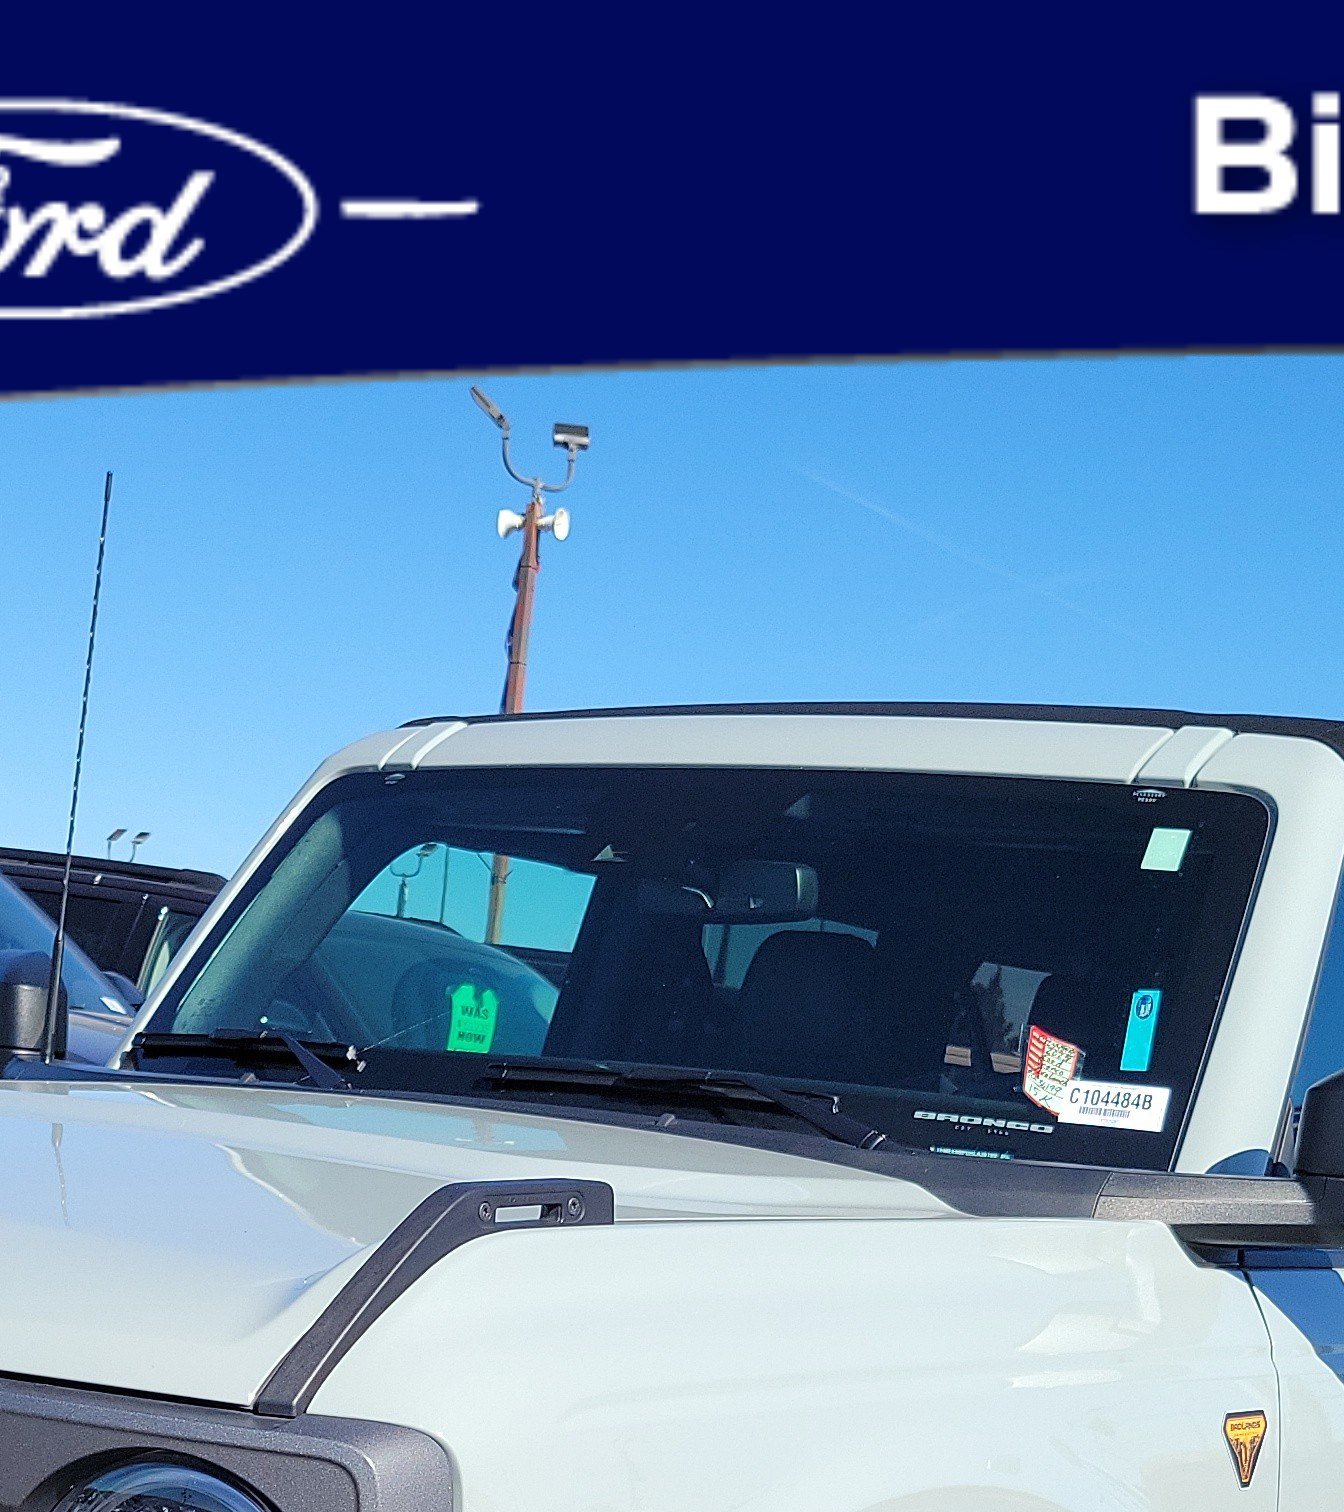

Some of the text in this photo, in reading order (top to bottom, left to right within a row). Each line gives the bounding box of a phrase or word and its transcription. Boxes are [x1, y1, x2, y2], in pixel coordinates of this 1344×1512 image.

[460, 1004, 490, 1021] WAS
[1069, 1087, 1154, 1111] C104484B
[913, 1110, 1054, 1134] BRONCO
